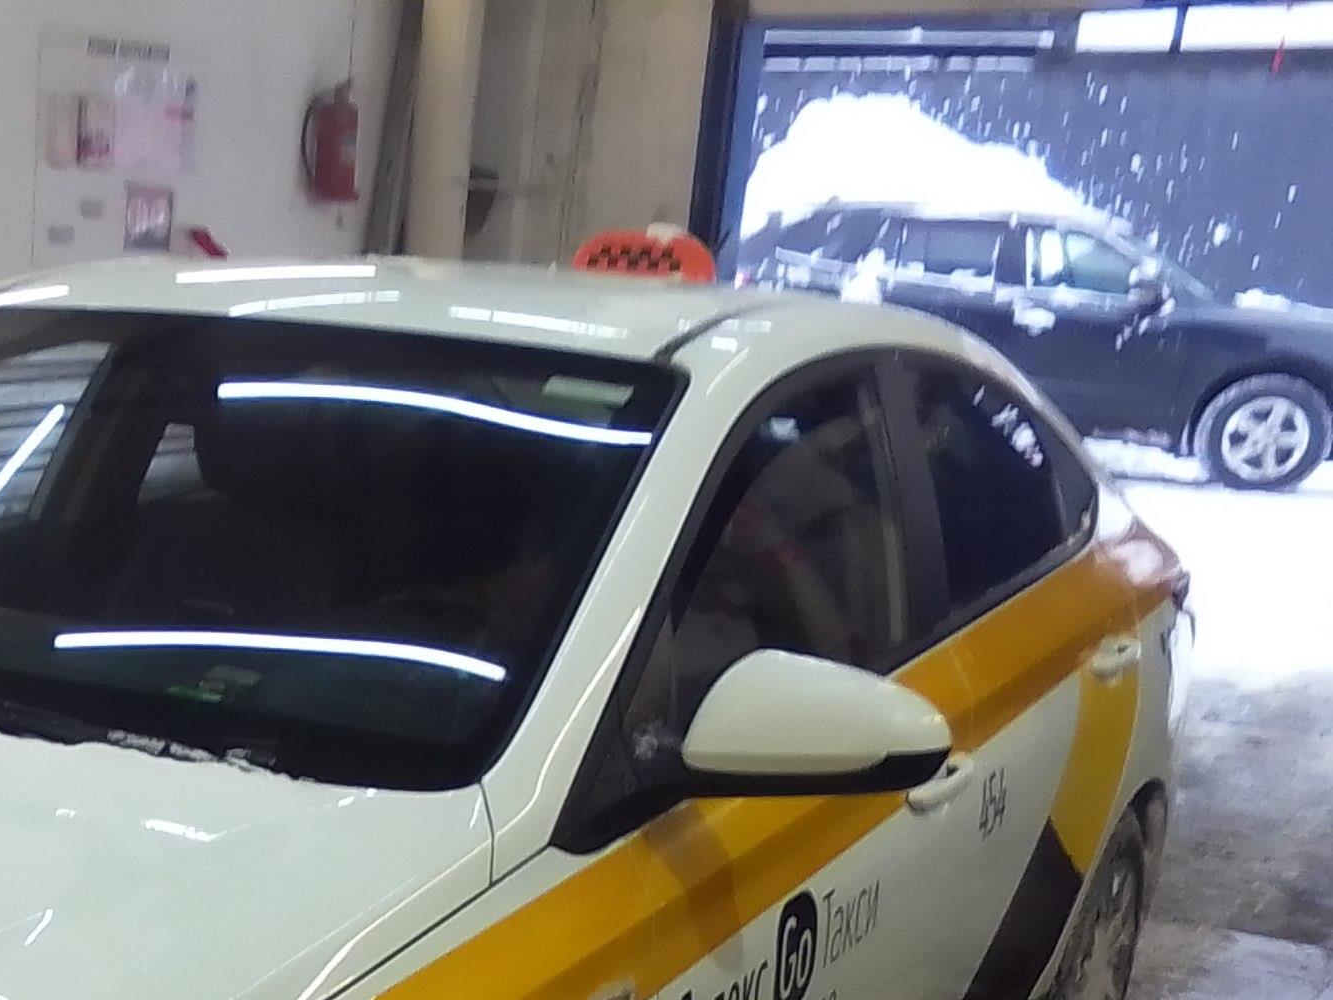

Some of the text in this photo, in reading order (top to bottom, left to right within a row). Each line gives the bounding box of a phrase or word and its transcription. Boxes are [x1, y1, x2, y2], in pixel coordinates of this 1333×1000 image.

[977, 767, 1007, 842] 454
[779, 915, 814, 1000] Go
[822, 879, 880, 969] Такси
